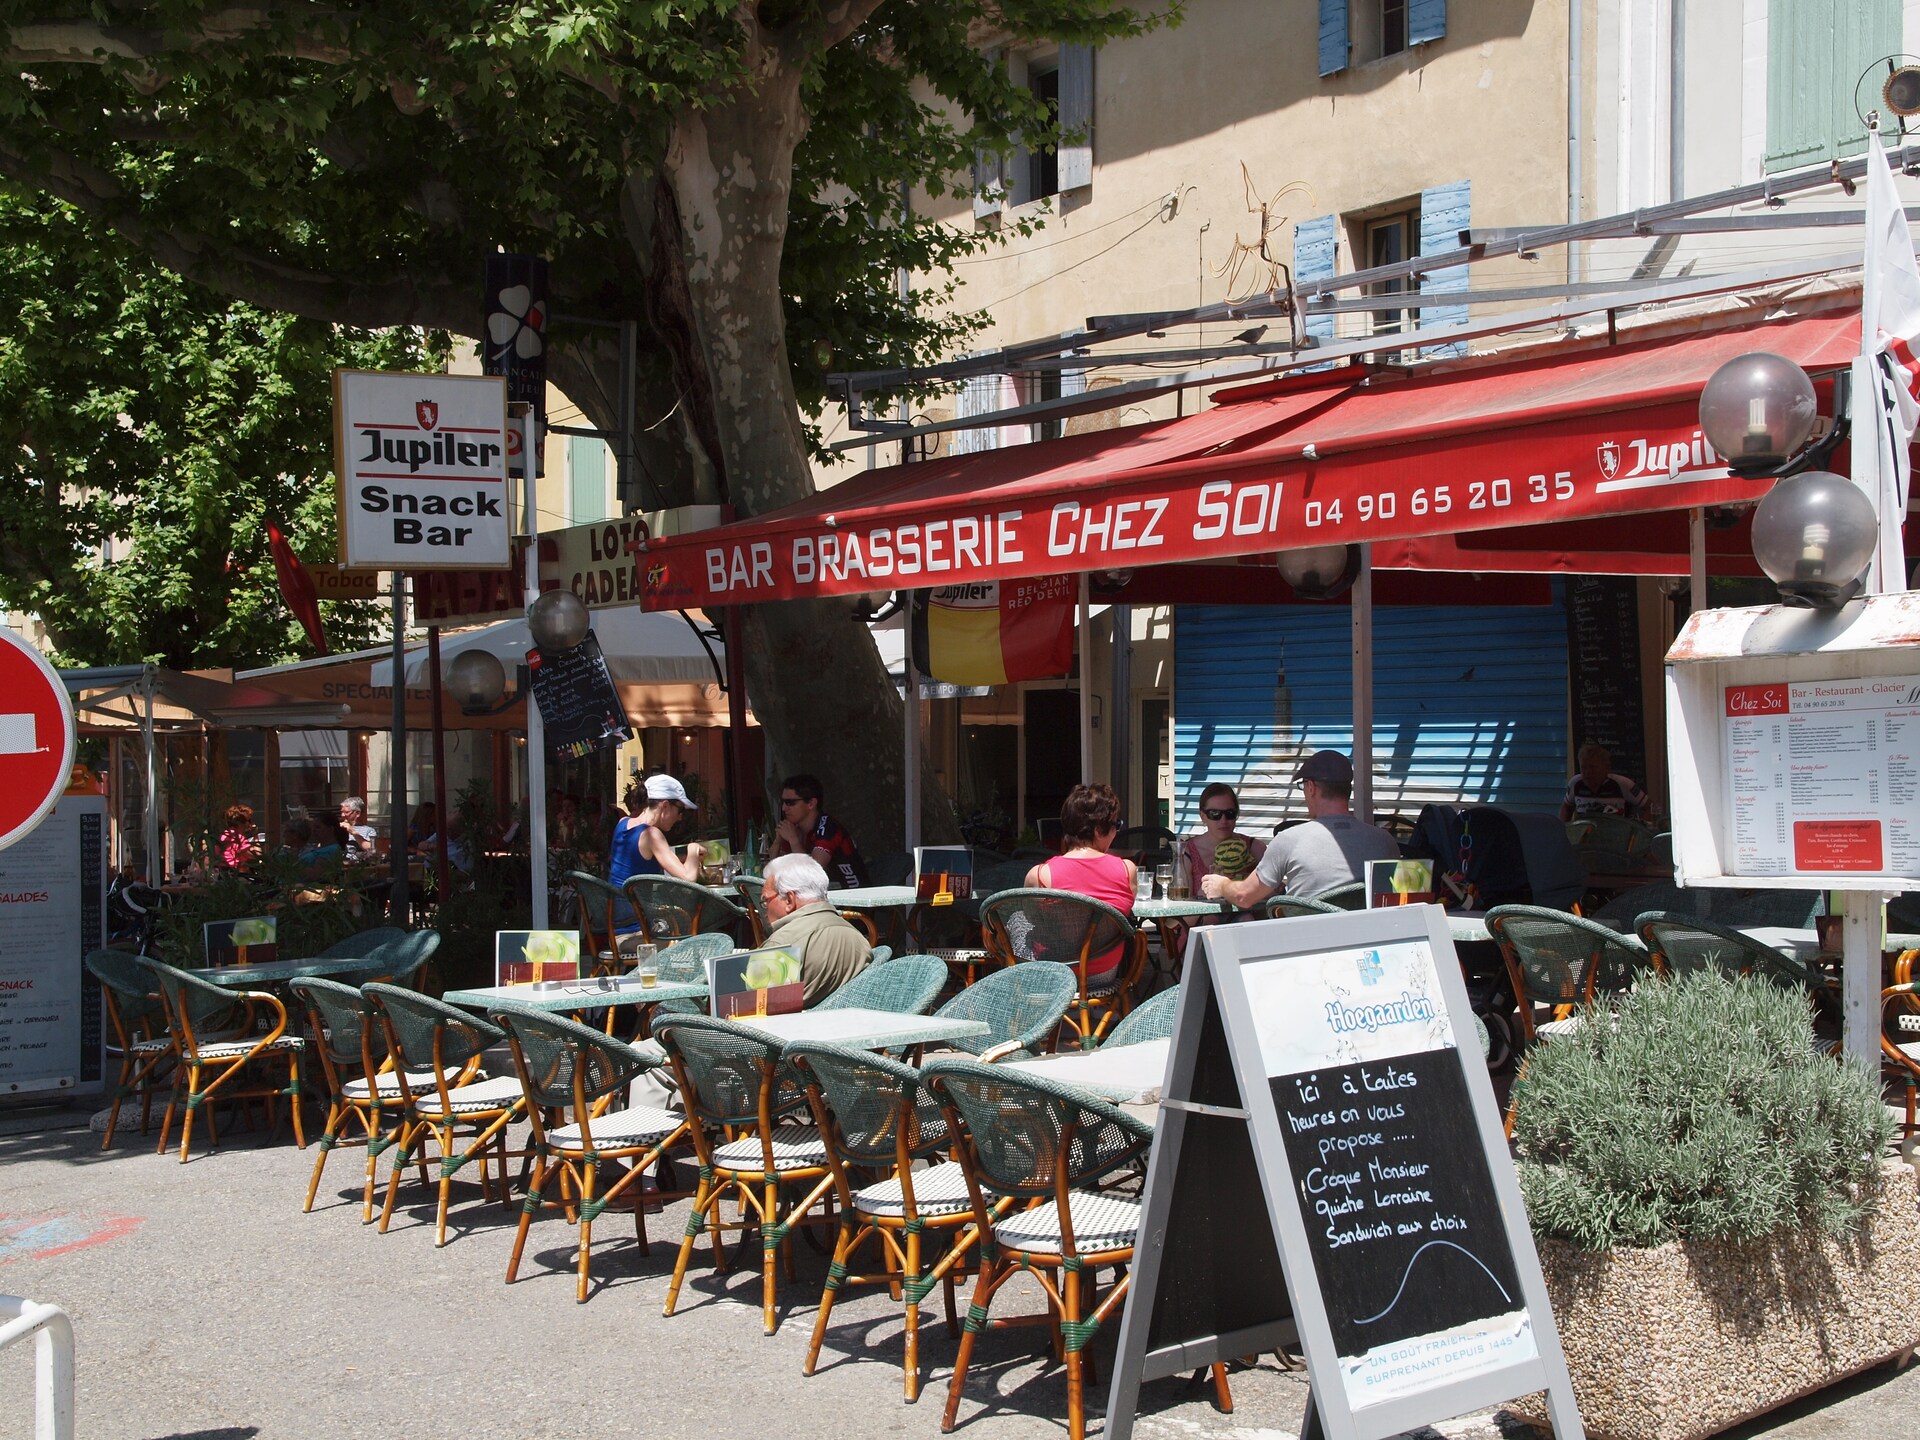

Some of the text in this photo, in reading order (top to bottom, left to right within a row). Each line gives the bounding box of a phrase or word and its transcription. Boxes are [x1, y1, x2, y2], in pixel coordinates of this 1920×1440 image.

[359, 429, 500, 473] Jupiler
[1625, 431, 1728, 481] Jupil
[360, 485, 502, 518] Snack
[1305, 472, 1575, 528] 04 90 65 20 35
[393, 518, 473, 547] Bar
[705, 480, 1284, 593] BAR BRASSERIE CHEZ SOI
[316, 570, 376, 588] Tabac
[571, 565, 640, 605] CADEA
[1017, 575, 1069, 597] BELGIAN
[1008, 596, 1032, 609] RED
[1730, 690, 1782, 711] Chez Soi
[1792, 683, 1906, 698] Bar Restaurant Glacier
[0, 891, 49, 904] ALADES
[1325, 991, 1435, 1033] Hoegaarden
[1295, 1074, 1320, 1104] ici
[1342, 1074, 1358, 1094] à
[1287, 1103, 1405, 1134] heures on vous
[1318, 1131, 1384, 1165] propose
[1306, 1155, 1430, 1195] Croque Monsieur
[1374, 1187, 1433, 1208] Lorraine
[1326, 1211, 1468, 1249] Sandwich aux choix
[1365, 1356, 1441, 1385] SURPRENANT
[1444, 1343, 1485, 1364] DEPUIS
[1489, 1336, 1514, 1350] 1445
